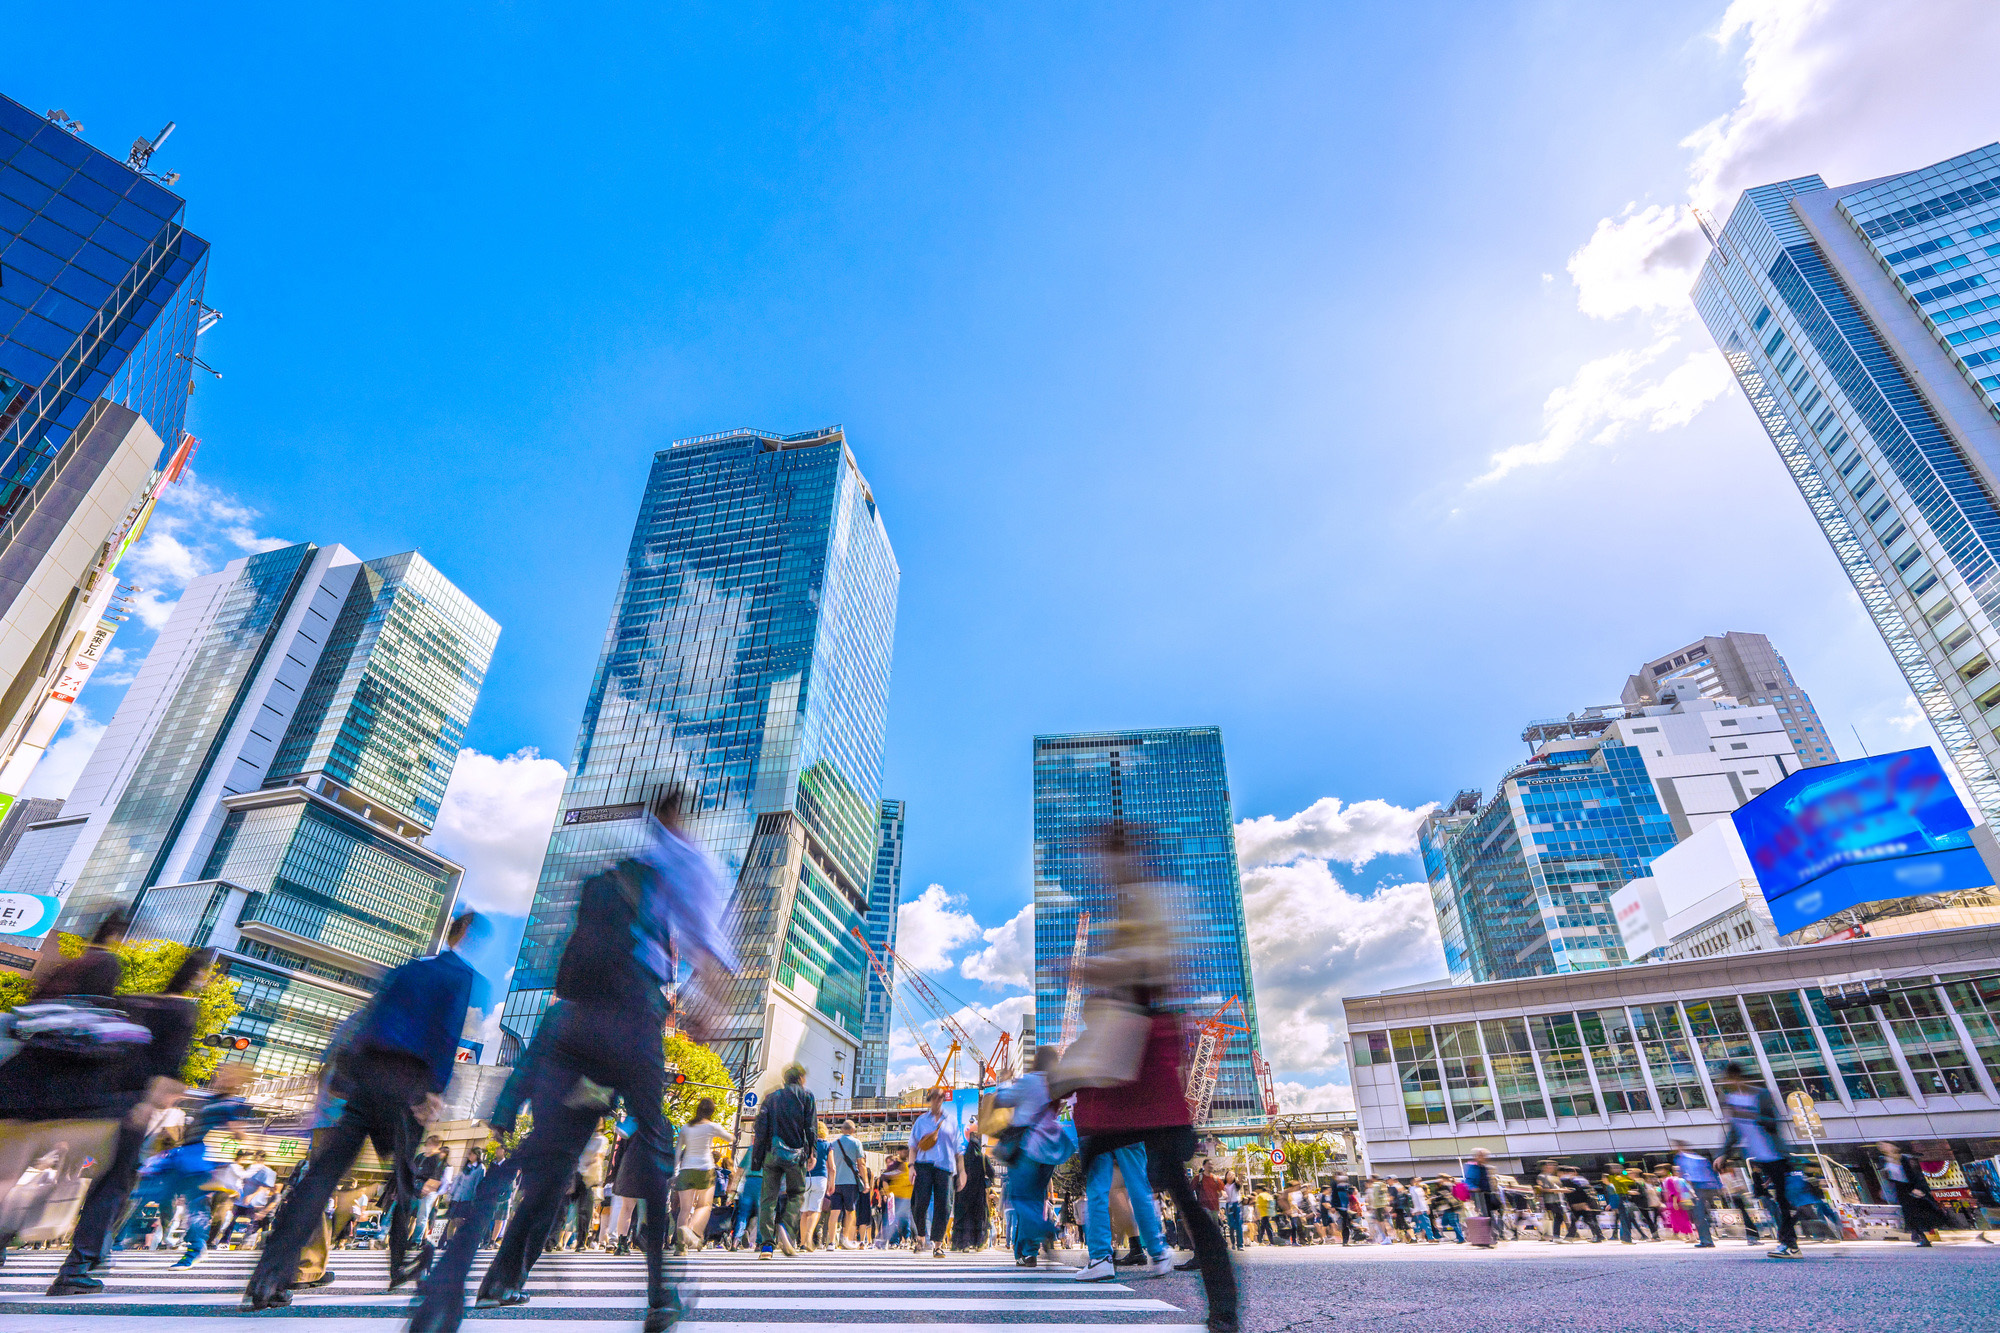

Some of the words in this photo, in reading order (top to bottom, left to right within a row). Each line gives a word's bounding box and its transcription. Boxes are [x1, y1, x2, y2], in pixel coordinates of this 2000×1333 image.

[1527, 777, 1556, 785] TOKYU
[1558, 775, 1589, 783] PLAZA
[579, 813, 612, 821] SCRAMBLE
[0, 907, 24, 919] EI
[455, 1052, 472, 1061] イト
